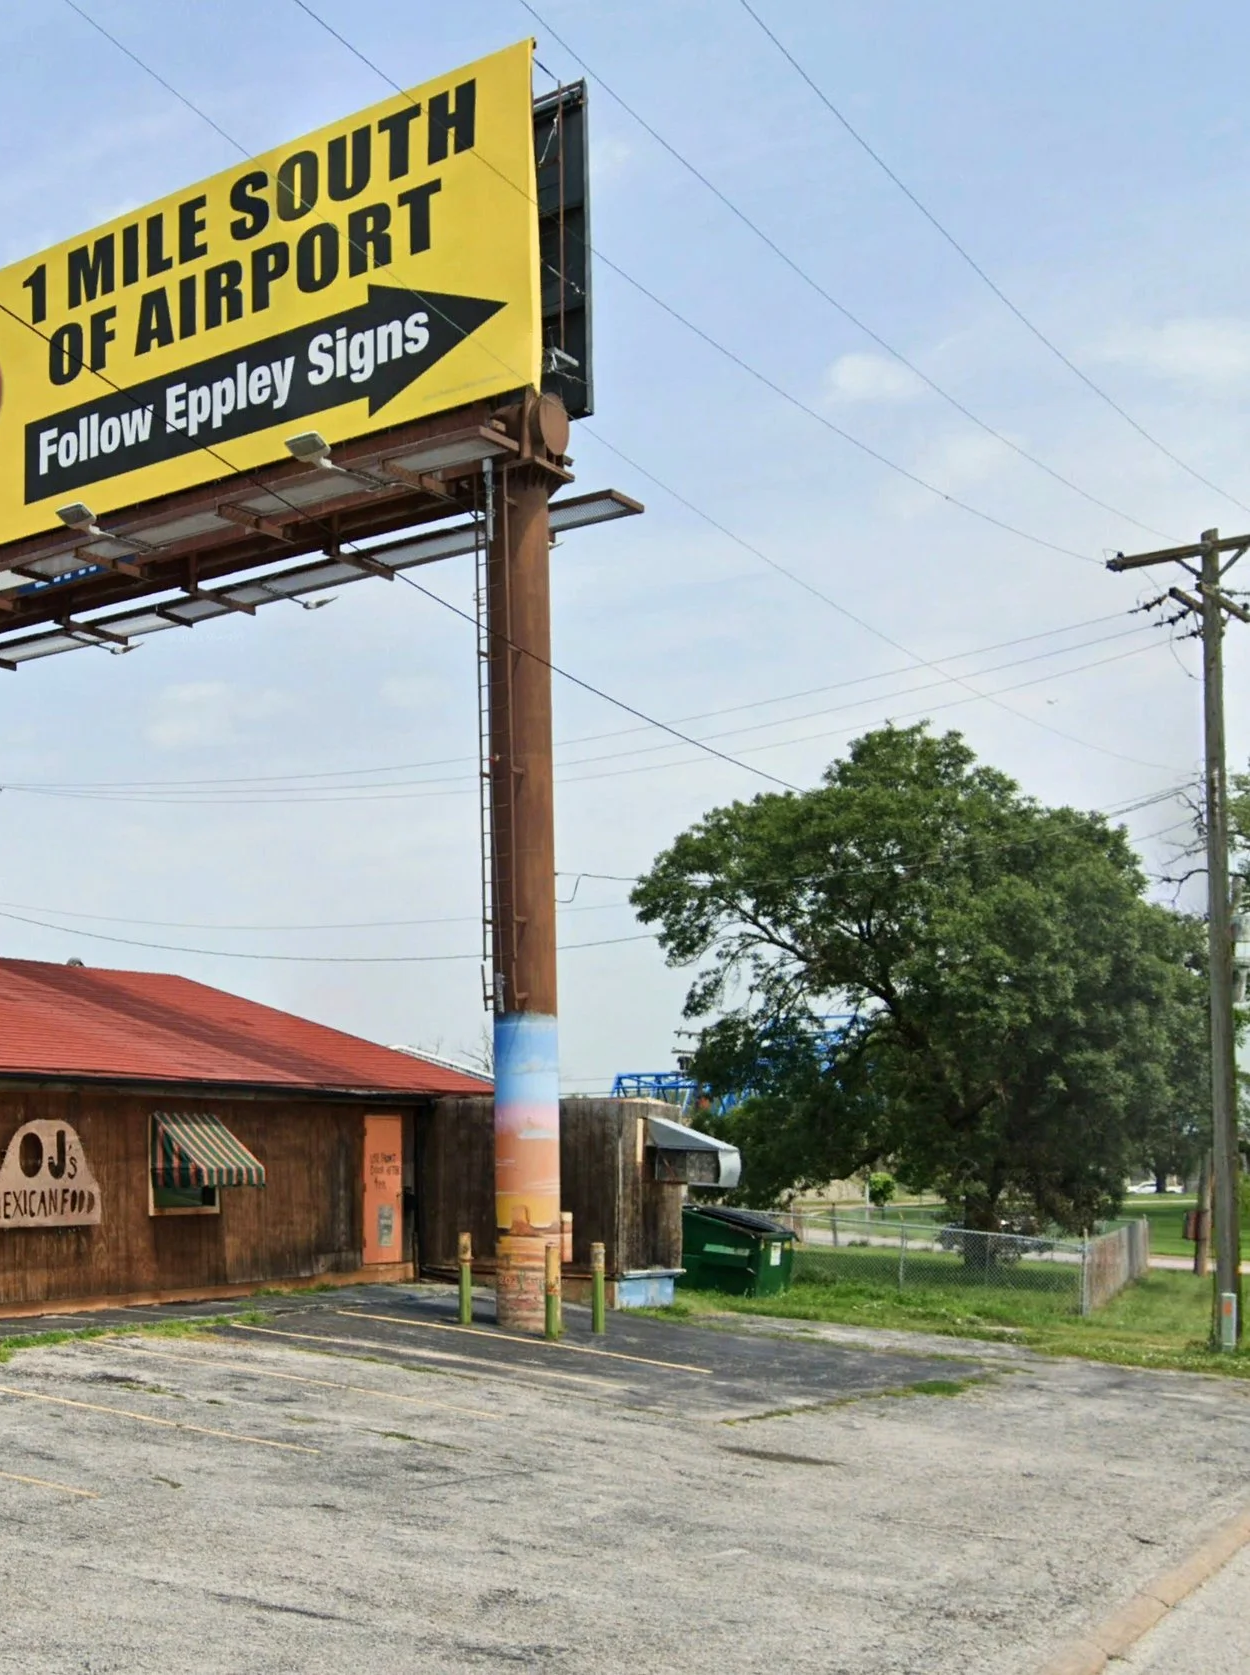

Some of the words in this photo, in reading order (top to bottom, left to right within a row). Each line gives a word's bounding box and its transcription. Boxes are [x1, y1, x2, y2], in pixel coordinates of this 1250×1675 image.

[22, 264, 47, 325] 1
[67, 194, 208, 309] MILE
[229, 78, 477, 241] SOUTH
[49, 309, 117, 387] OF
[133, 178, 442, 357] AIRPORT
[38, 404, 153, 476] Follow
[165, 355, 296, 436] Eppley
[306, 311, 430, 391] Signs
